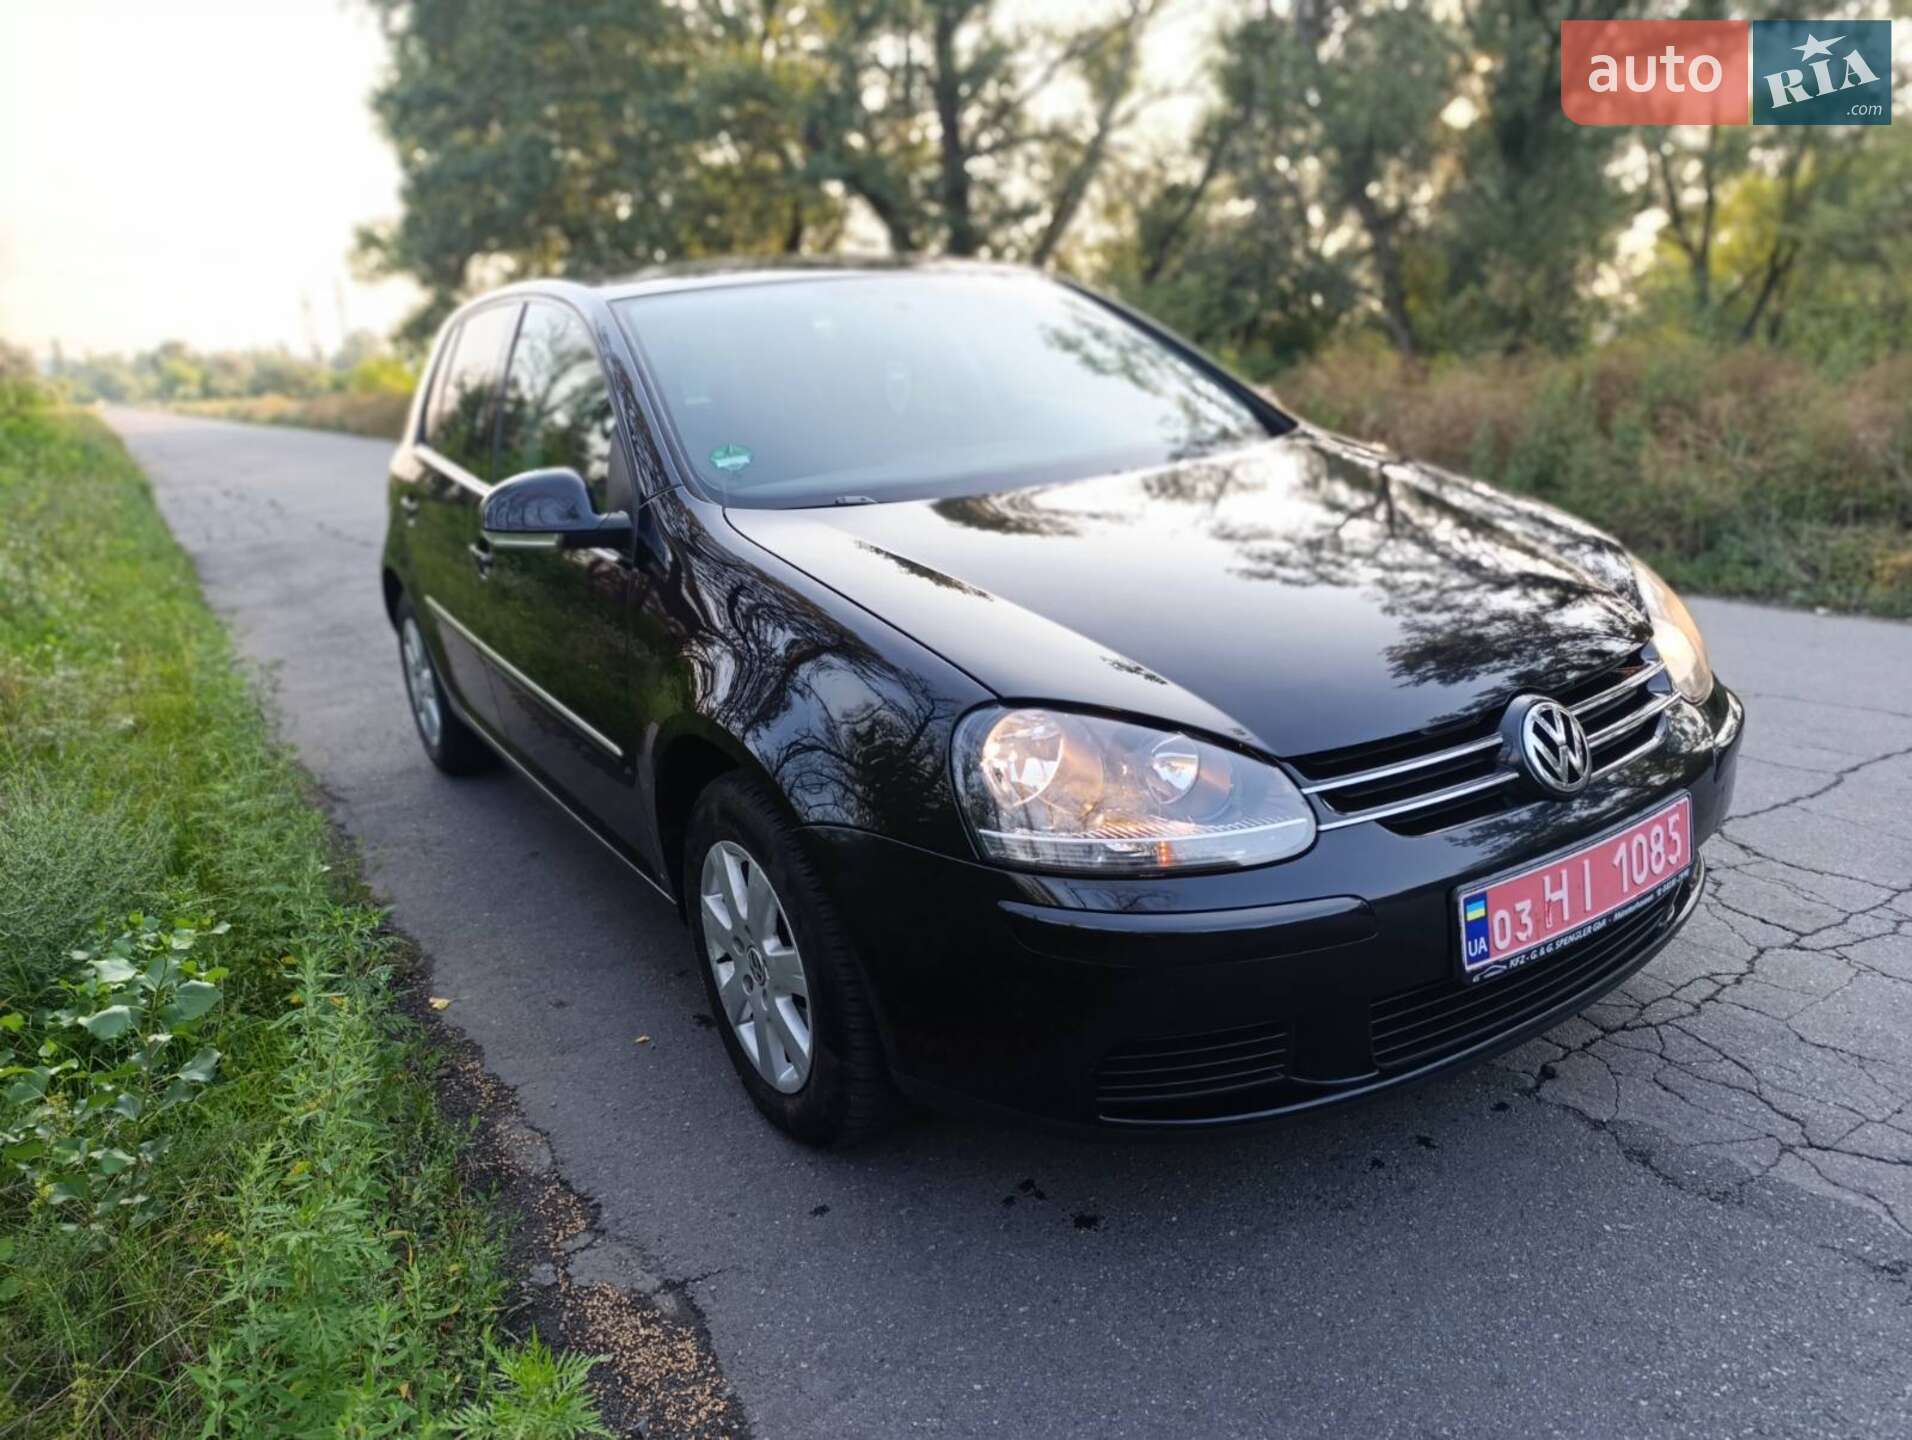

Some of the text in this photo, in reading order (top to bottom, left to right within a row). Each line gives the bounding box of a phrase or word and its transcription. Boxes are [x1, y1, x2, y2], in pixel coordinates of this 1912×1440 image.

[1492, 899, 1534, 950] 03
[1612, 813, 1681, 893] 1085
[1468, 936, 1488, 957] UA
[1509, 953, 1526, 969] KFZ
